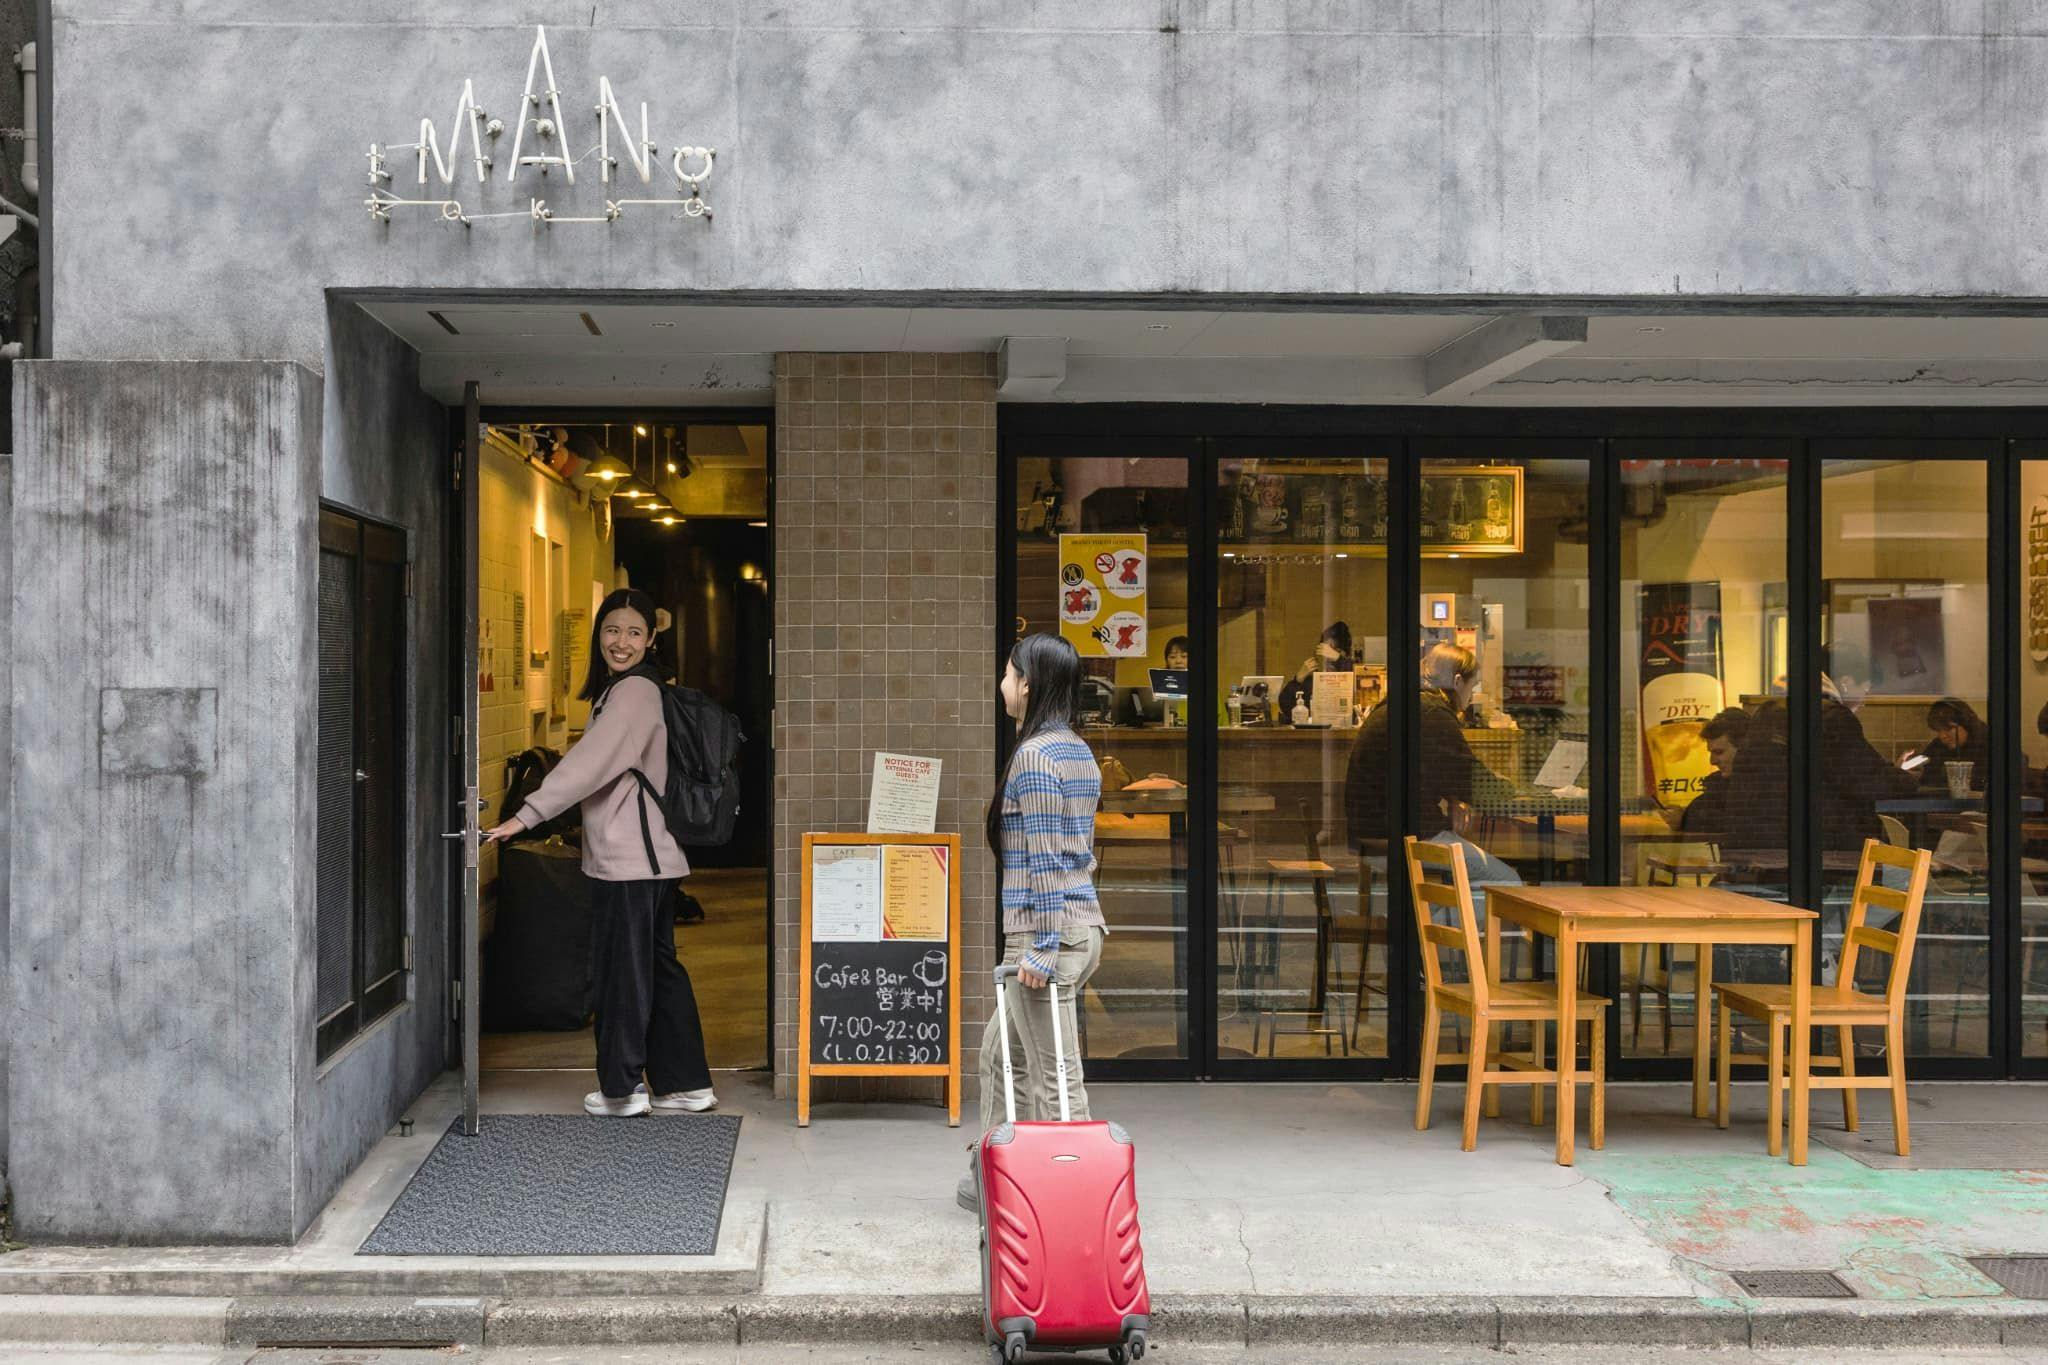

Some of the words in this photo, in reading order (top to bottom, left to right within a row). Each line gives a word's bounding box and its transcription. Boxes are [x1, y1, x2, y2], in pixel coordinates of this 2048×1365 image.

[884, 757, 914, 767] NOTICE
[915, 761, 931, 769] FOR
[832, 848, 857, 856] CAFE
[875, 967, 909, 986] Bar
[876, 987, 943, 1014] 営業中!
